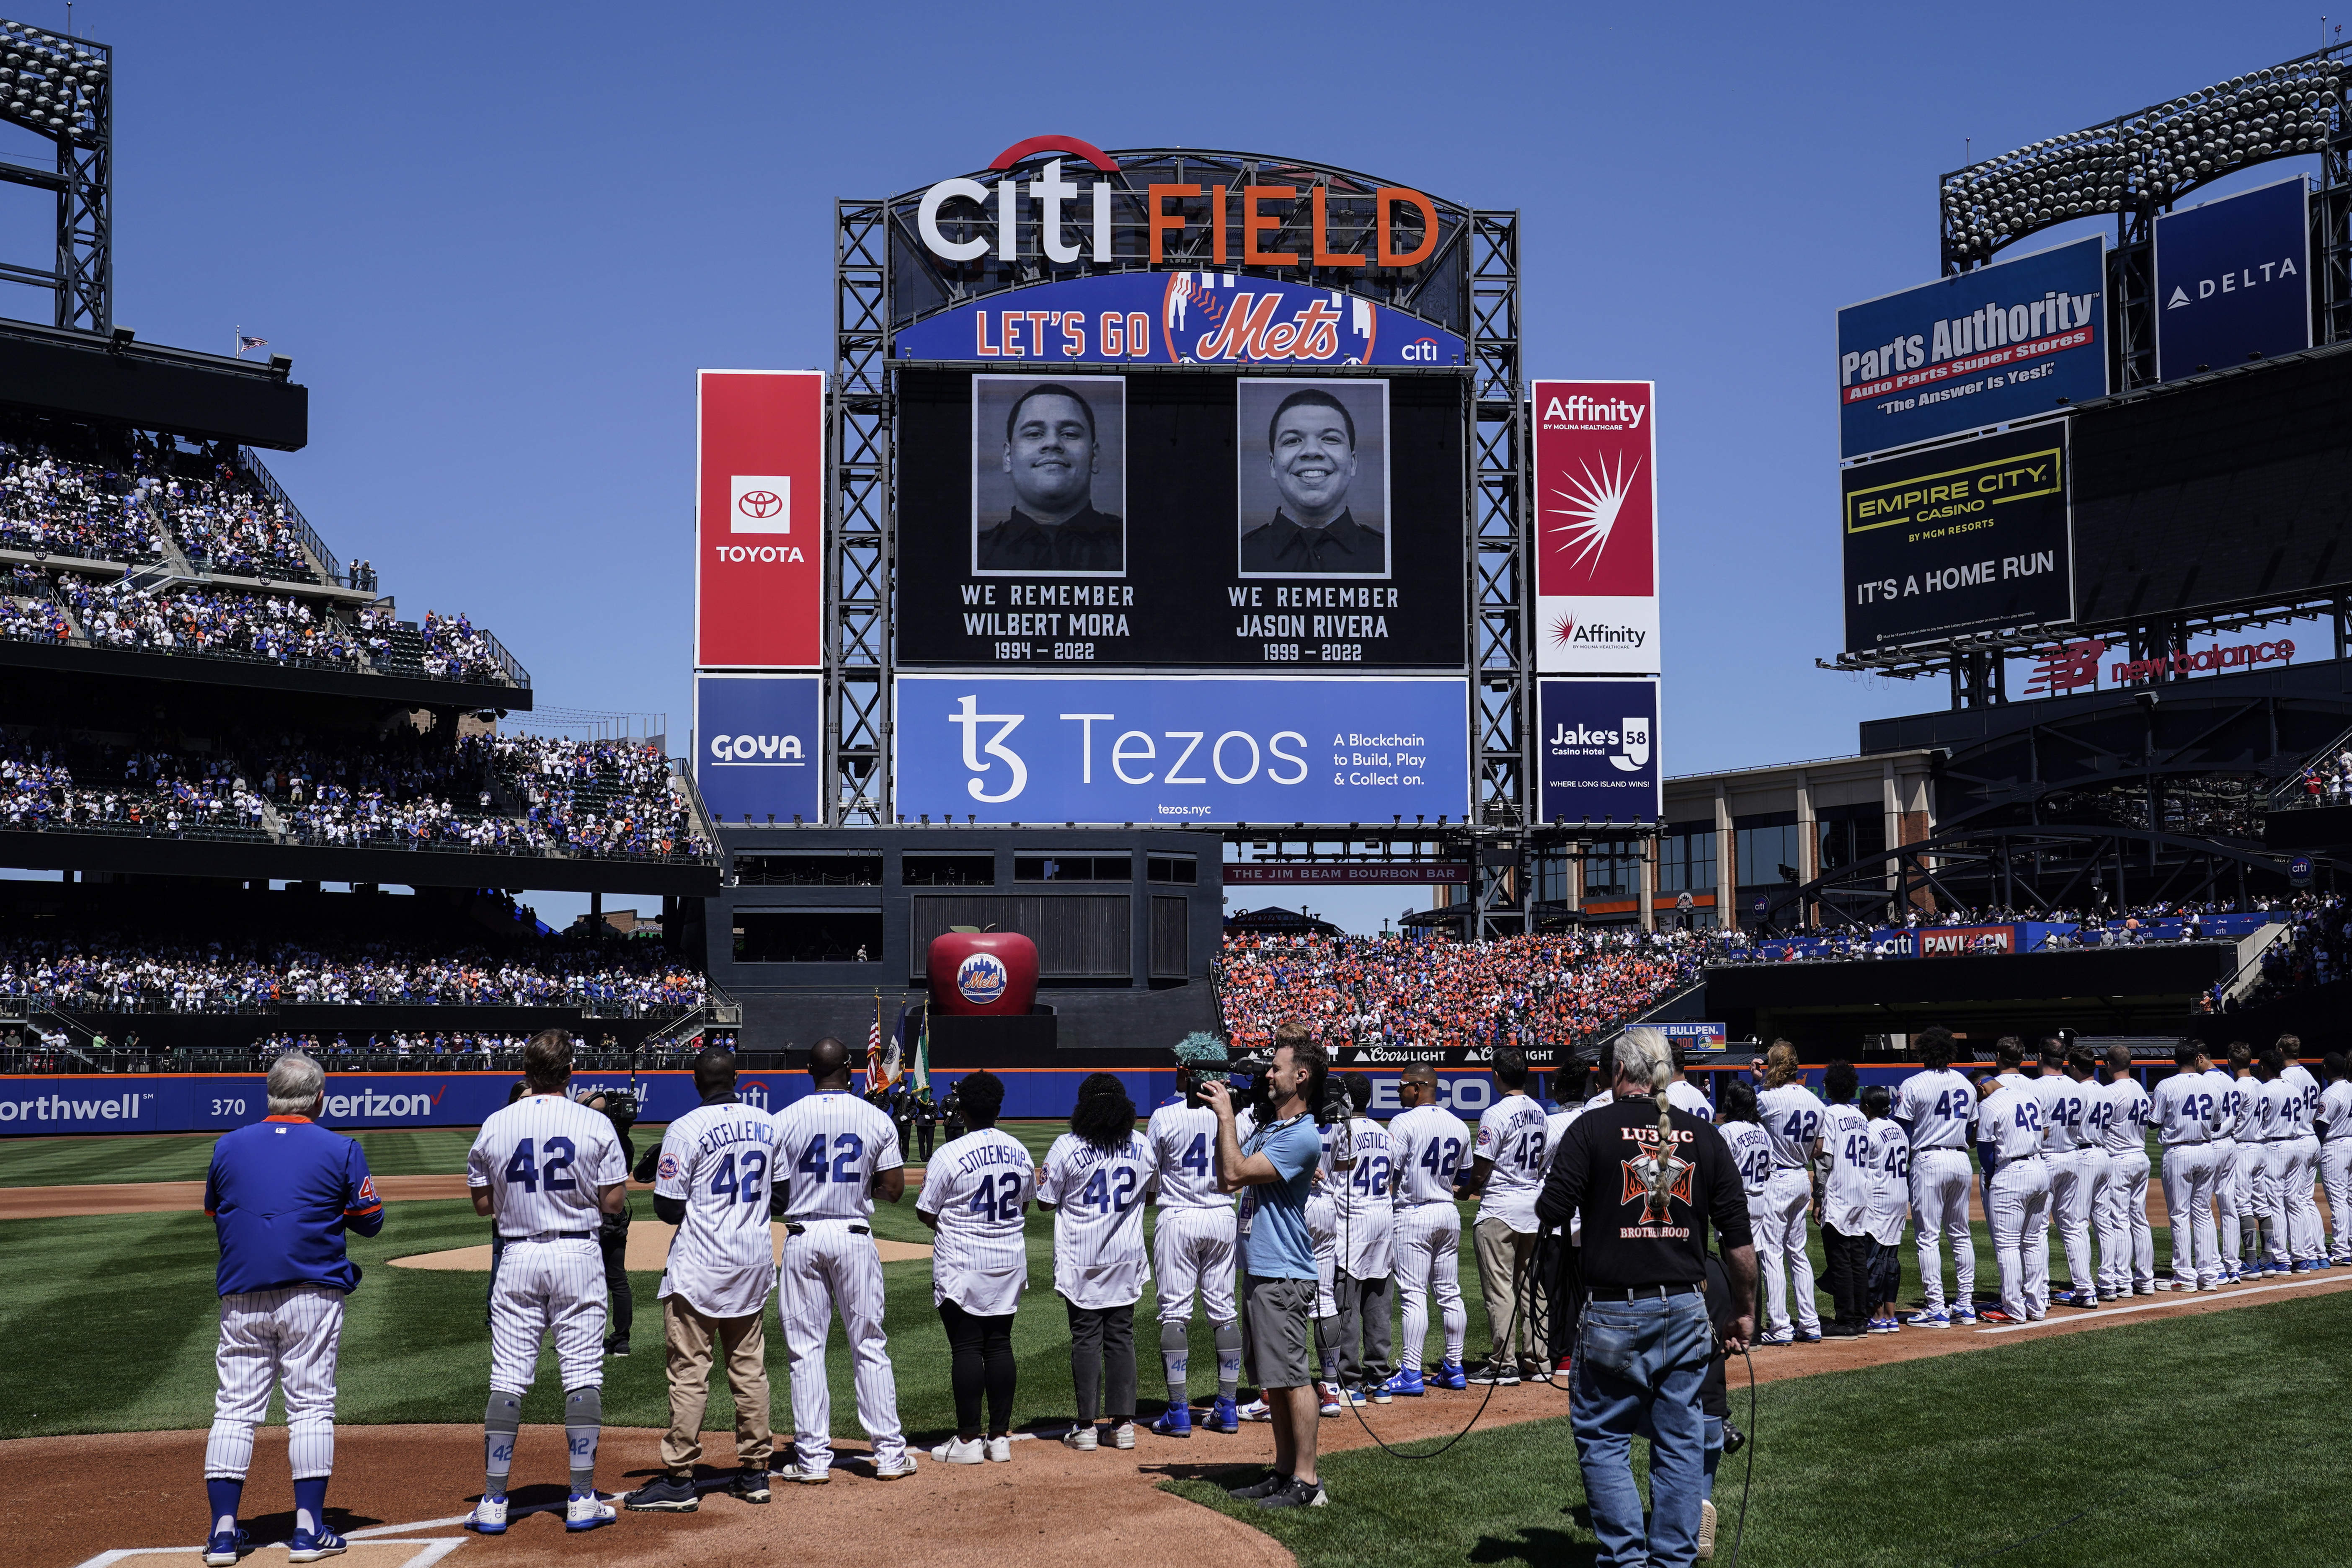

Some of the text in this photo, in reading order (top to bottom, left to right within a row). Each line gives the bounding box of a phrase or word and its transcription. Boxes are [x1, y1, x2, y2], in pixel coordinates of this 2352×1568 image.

[918, 159, 1439, 268] citi FIELD
[2200, 257, 2297, 300] DELTA
[976, 310, 1149, 356] LET'S GO
[1197, 292, 1341, 360] Mets
[1843, 291, 2093, 386] Parts Authority
[1402, 342, 1437, 361] citi
[1850, 331, 2086, 400] Auto Parts Super Stores
[1918, 380, 1983, 406] Answer
[1987, 376, 2004, 390] Is
[1544, 395, 1645, 429] Affinity
[1859, 464, 2047, 518] EMPIRE CITY
[1916, 499, 1985, 522] CASINO
[1909, 519, 1994, 542] BY MGM RESORTS
[716, 546, 804, 563] TOYOTA
[1904, 575, 1919, 597] A
[1926, 561, 1996, 593] HOME
[2003, 550, 2053, 579] RUN
[961, 585, 1134, 606] WE REMEMBER
[1228, 586, 1398, 608] WE REMEMBER
[963, 613, 1129, 636] WILBERT MORA
[1236, 615, 1389, 638] JASON RIVERA
[1573, 624, 1646, 648] Affinity
[995, 642, 1094, 659] 1994 2022
[1263, 644, 1361, 661] 1999 2022
[2112, 639, 2295, 682] new balance
[1333, 734, 1425, 747] A Blockchain
[1550, 723, 1646, 745] Jake's 58
[1060, 713, 1308, 785] Tezos
[1333, 753, 1426, 769] to Build, Play
[1334, 773, 1425, 785] & Collect on.
[1158, 804, 1211, 817] tezos.nyc
[1233, 869, 1455, 879] THE JIM BEAM BOURBON BAR
[2292, 863, 2307, 872] citi
[1883, 933, 2007, 955] citi PAVION
[964, 971, 1000, 989] Mets
[1670, 1026, 1718, 1035] BULLPEN.
[1370, 1047, 1445, 1062] Coors LIGHT
[1526, 1050, 1554, 1060] IGHT
[211, 1099, 245, 1115] 370
[1934, 1089, 1968, 1121] 42
[2182, 1094, 2213, 1121] 42
[2222, 1091, 2240, 1117] 42
[2254, 1096, 2269, 1121] 42
[2281, 1097, 2301, 1121] 42
[2304, 1085, 2318, 1109] 42
[2016, 1102, 2042, 1132] 42
[2053, 1098, 2081, 1127] 42
[2089, 1101, 2113, 1129] 42
[2128, 1099, 2148, 1126] 42
[1783, 1110, 1817, 1142] 42
[1838, 1116, 1869, 1134] COURAGE
[1879, 1129, 1906, 1144] INTEGRIT
[699, 1121, 775, 1155] EXCELLENCE
[1356, 1130, 1390, 1152] JUSTICE
[1736, 1130, 1771, 1146] PERSISTEN
[799, 1133, 863, 1183] 42
[958, 1144, 1026, 1174] CITIZENSHIP
[1182, 1133, 1217, 1176] 4
[1421, 1137, 1461, 1175] 42
[1514, 1131, 1544, 1170] 42
[1845, 1134, 1869, 1168] 42
[1885, 1146, 1907, 1178] 42
[506, 1136, 576, 1193] 42
[1353, 1156, 1390, 1196] 42
[1741, 1150, 1769, 1183] 42
[711, 1150, 767, 1204] 42
[970, 1172, 1021, 1222] 42
[1083, 1166, 1136, 1214] 42
[1620, 1227, 1690, 1238] BROTHERHOOD
[1171, 1359, 1187, 1371] 42
[1224, 1359, 1239, 1370] 42
[493, 1445, 513, 1461] 42
[570, 1438, 589, 1455] 42
